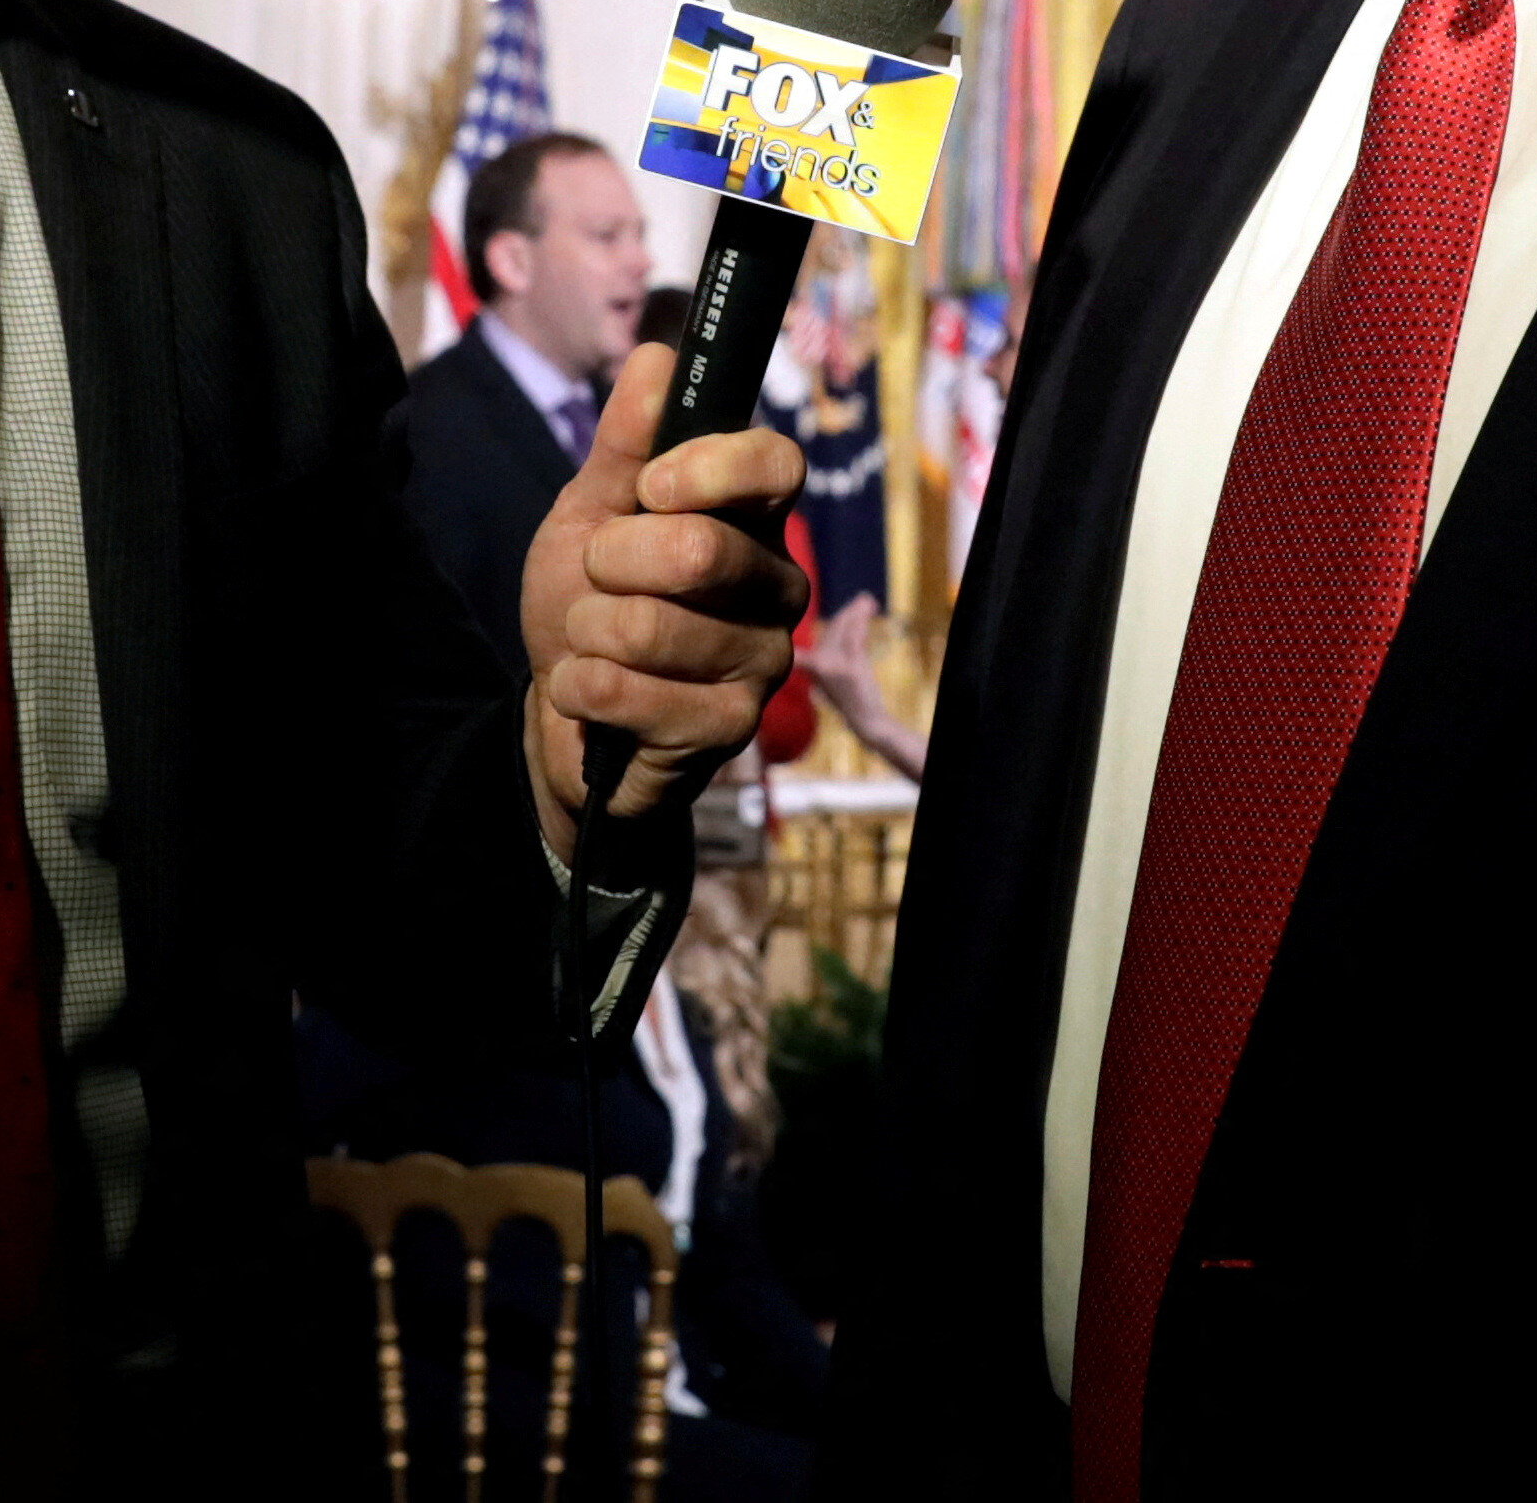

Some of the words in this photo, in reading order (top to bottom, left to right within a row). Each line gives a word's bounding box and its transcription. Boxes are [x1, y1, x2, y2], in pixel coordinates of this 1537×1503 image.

[704, 43, 870, 146] FOX
[853, 101, 875, 129] &
[716, 116, 881, 198] friends
[682, 386, 697, 408] 46
[690, 354, 708, 384] MD
